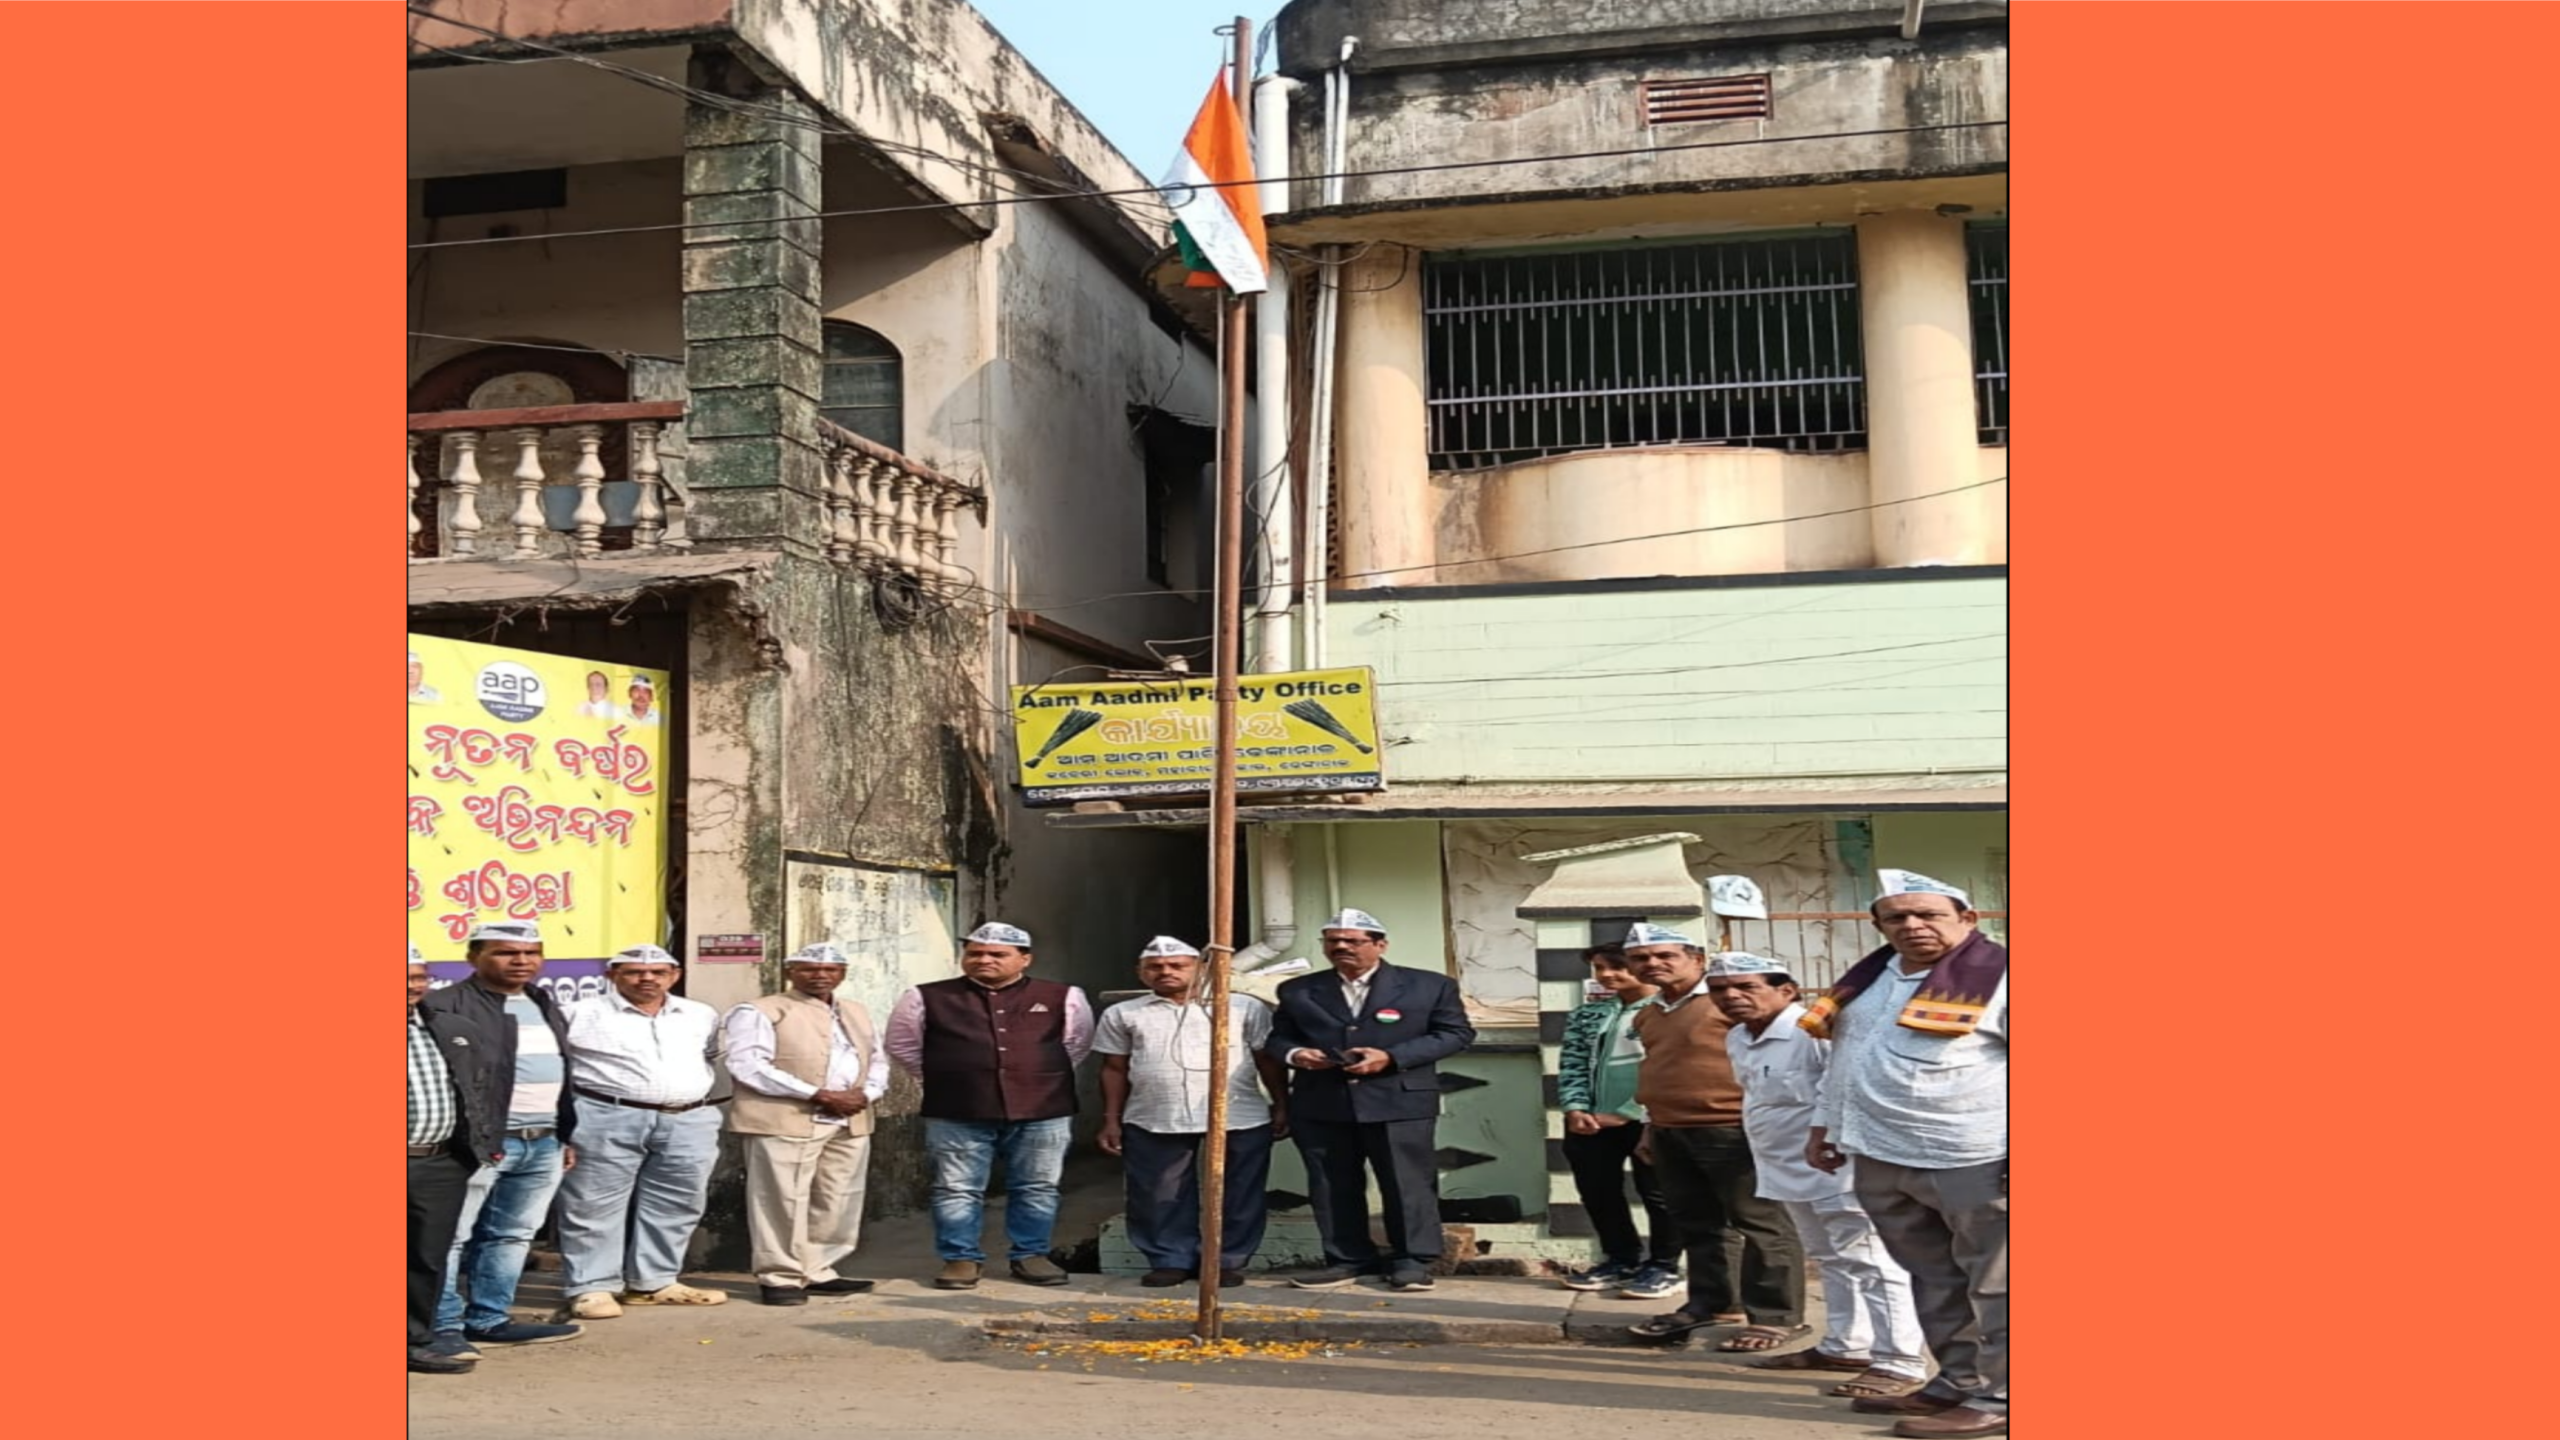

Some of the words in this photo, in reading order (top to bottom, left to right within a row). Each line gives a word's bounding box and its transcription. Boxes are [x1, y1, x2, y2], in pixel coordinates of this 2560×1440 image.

[482, 671, 539, 705] aap
[1019, 693, 1080, 709] Aam
[1092, 688, 1179, 706] Aadmi
[1274, 681, 1362, 698] Office
[423, 724, 537, 783] ନୂତନ
[554, 723, 655, 793] ବର୍ଷର
